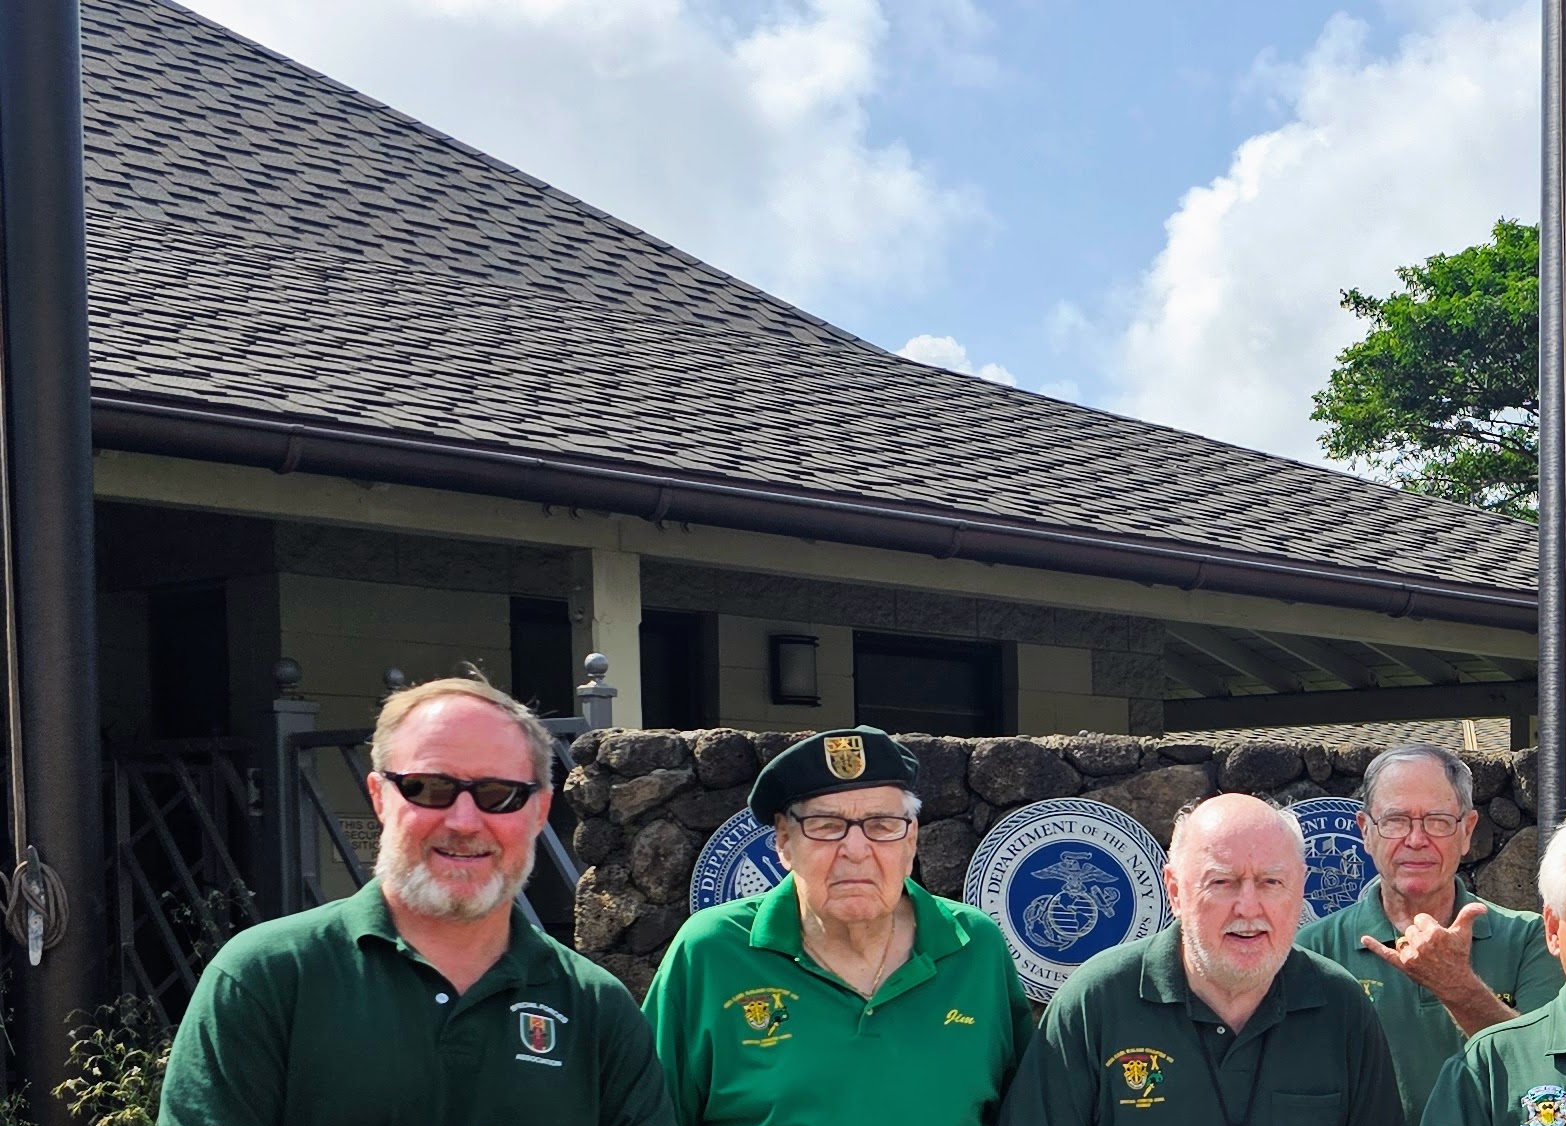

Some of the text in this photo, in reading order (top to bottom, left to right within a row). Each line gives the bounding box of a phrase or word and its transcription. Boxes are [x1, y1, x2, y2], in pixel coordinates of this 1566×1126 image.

[700, 817, 759, 892] DEPARTM
[987, 820, 1155, 900] DEPARTMENT OF THE NAVY
[1021, 959, 1069, 983] STATES
[943, 1009, 976, 1026] Jim
